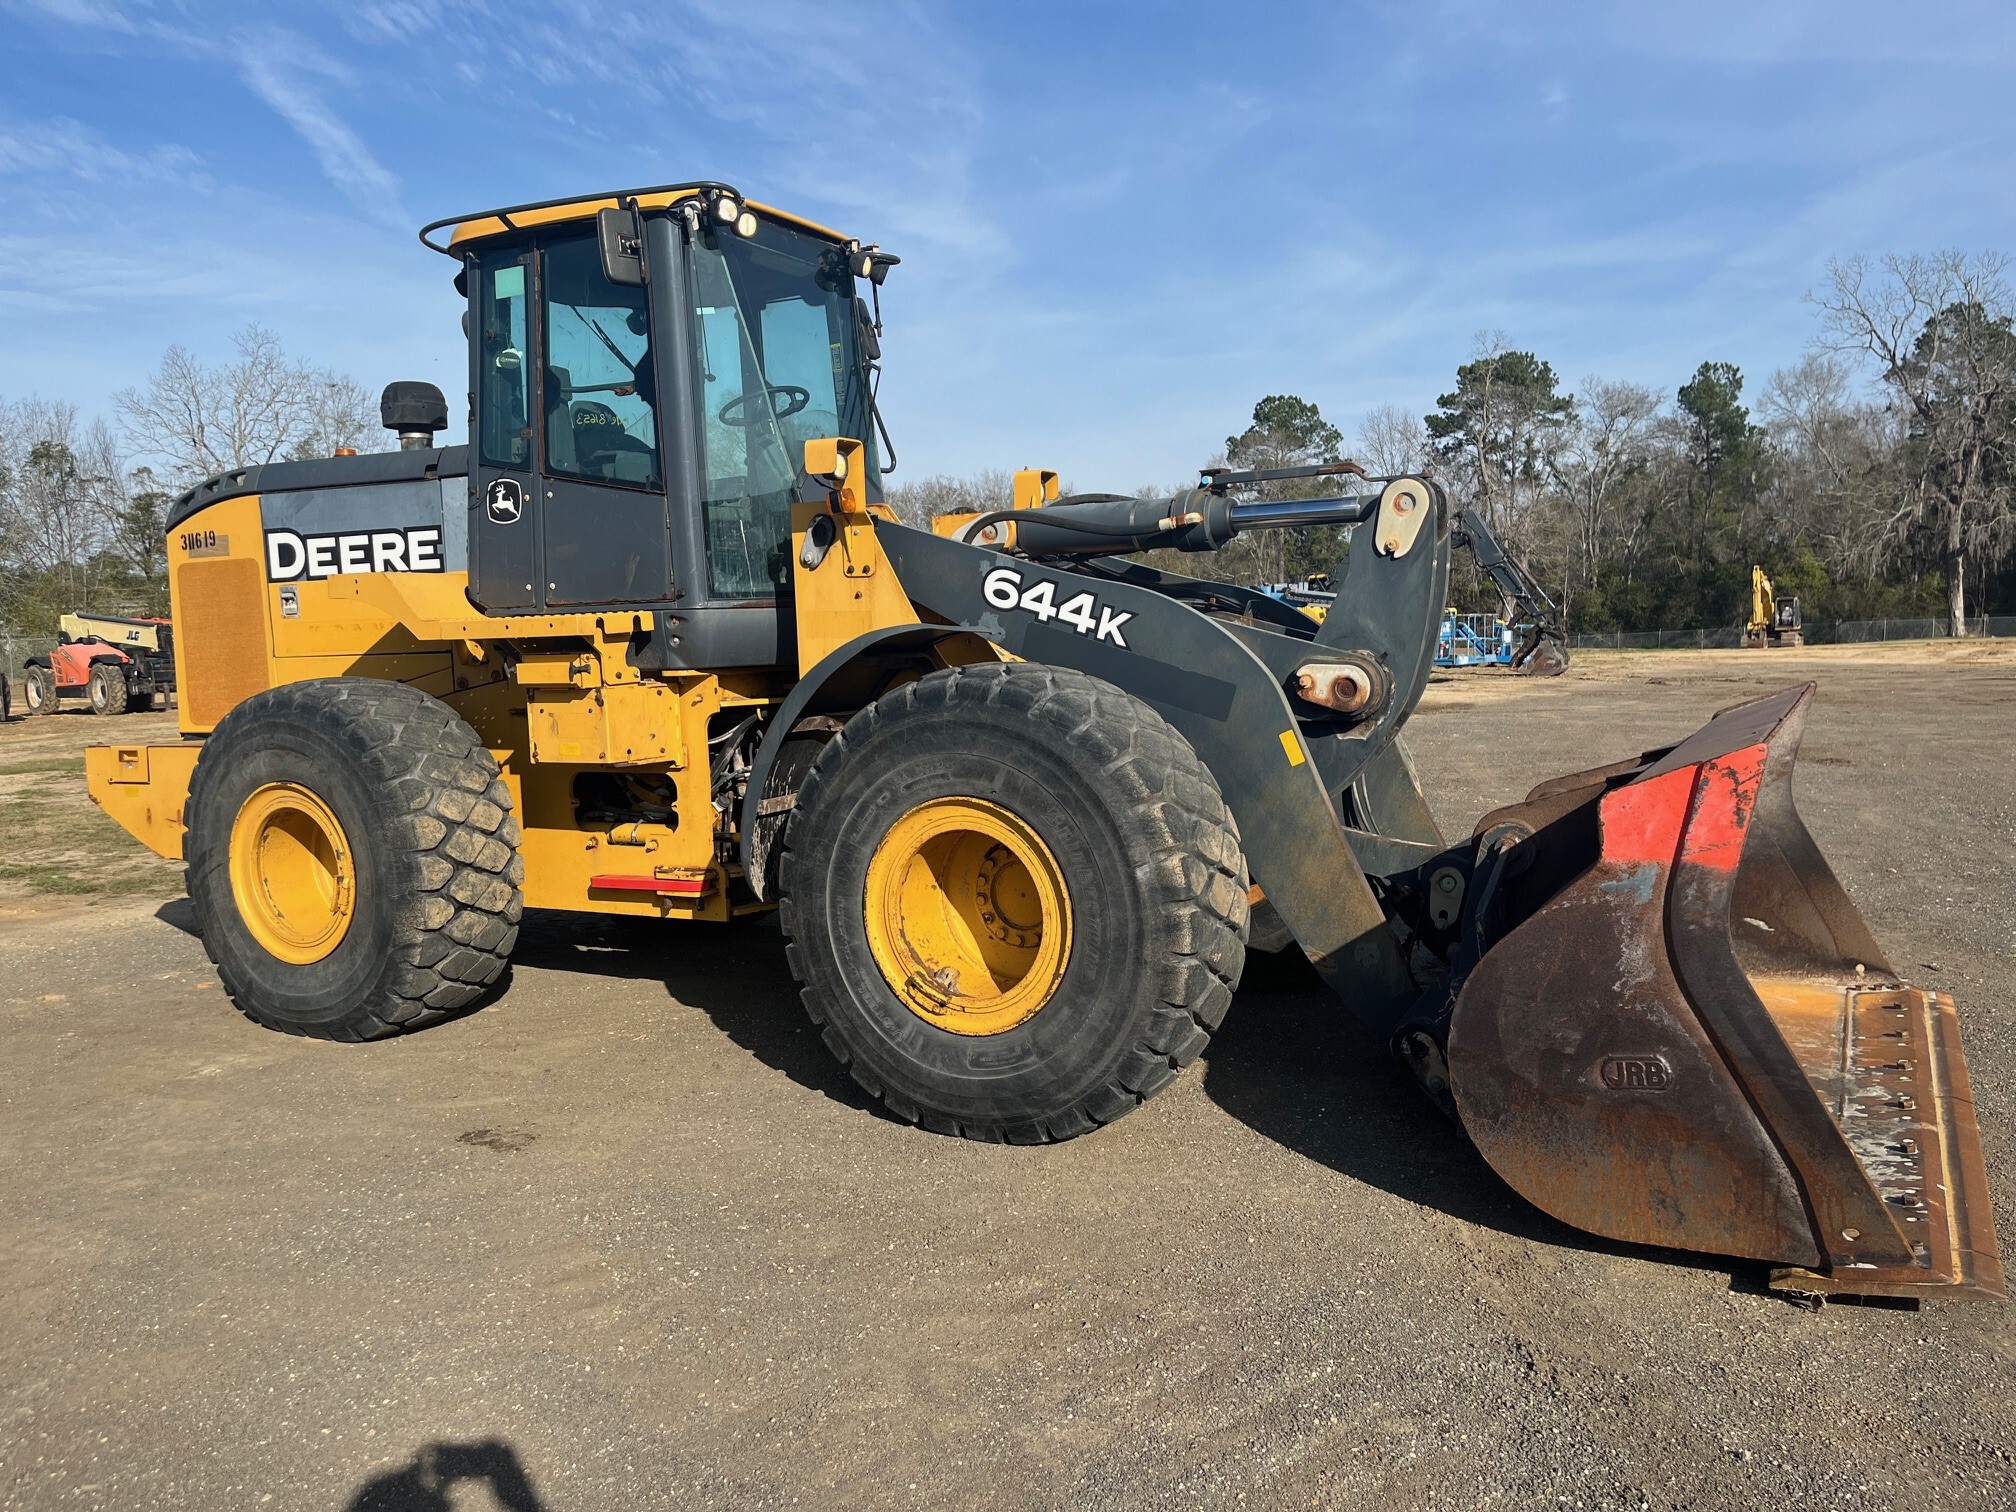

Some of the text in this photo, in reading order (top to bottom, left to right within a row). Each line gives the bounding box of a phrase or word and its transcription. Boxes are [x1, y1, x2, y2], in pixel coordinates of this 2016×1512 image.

[267, 529, 441, 579] DEERE
[983, 569, 1133, 648] 644K
[126, 630, 140, 641] JLG
[1606, 1060, 1667, 1088] JRB
